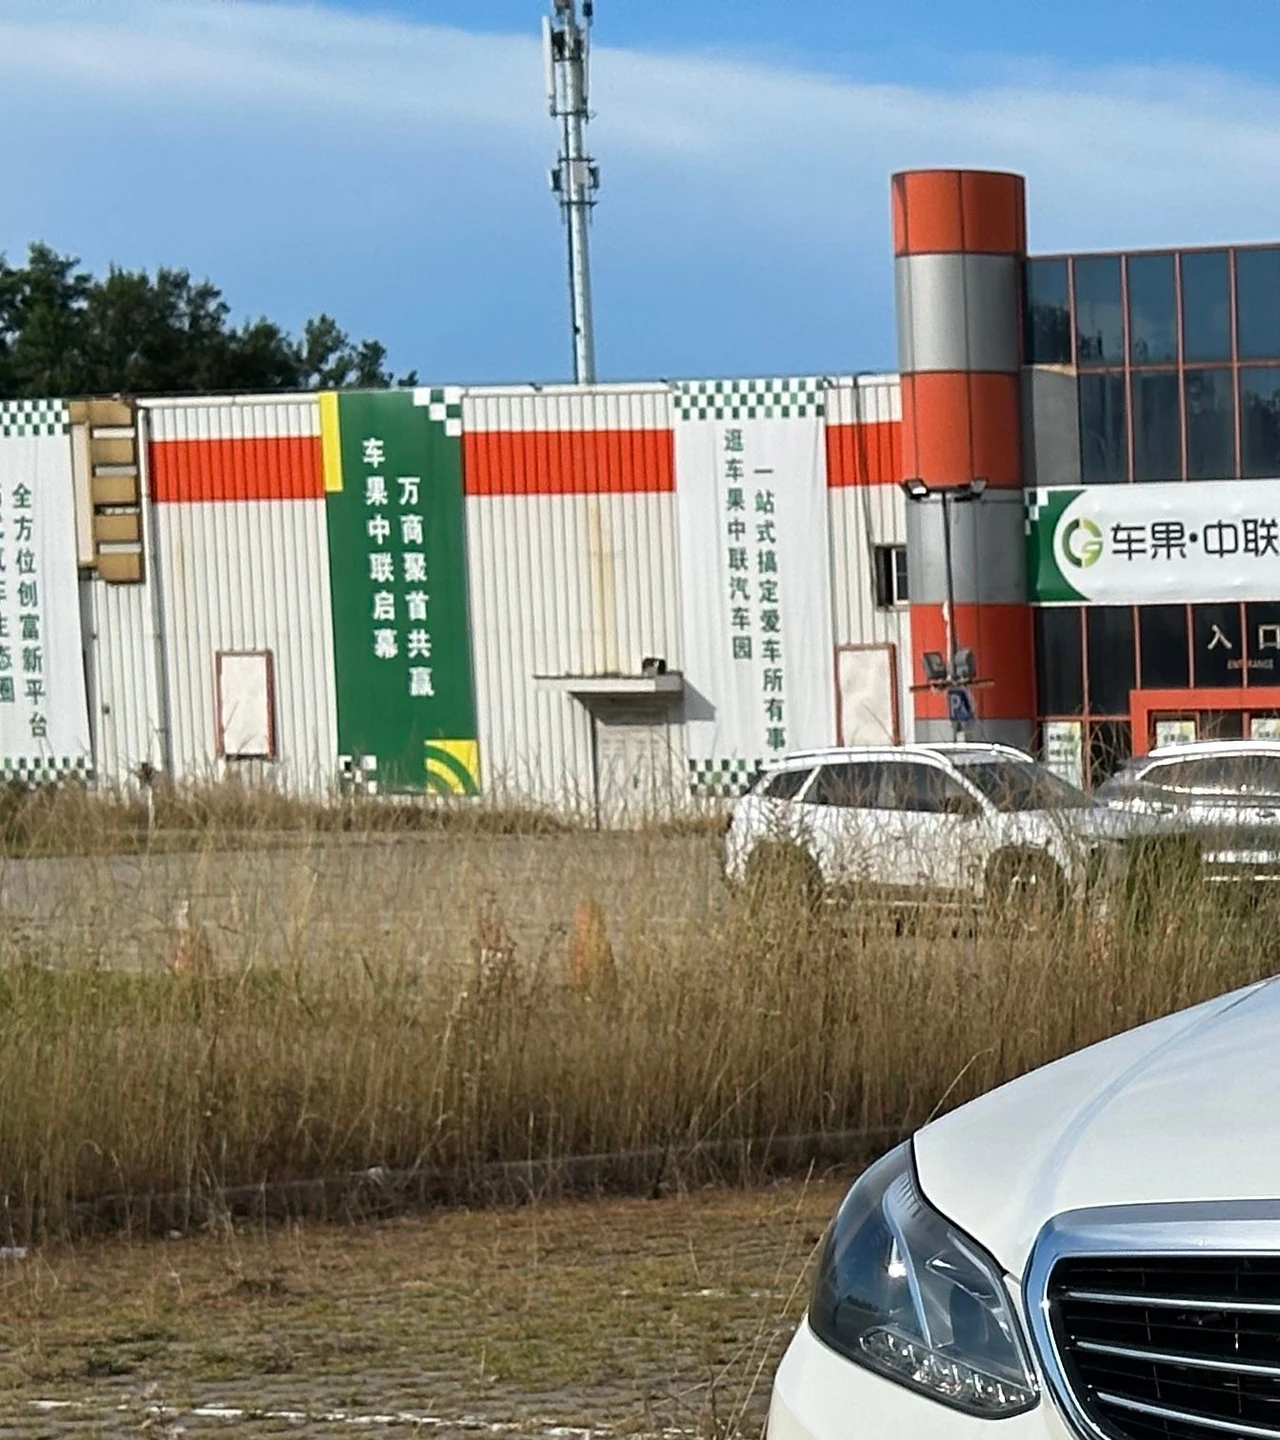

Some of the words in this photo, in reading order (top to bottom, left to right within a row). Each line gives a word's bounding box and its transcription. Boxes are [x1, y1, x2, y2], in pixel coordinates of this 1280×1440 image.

[12, 482, 48, 738] 全方位创富新平台
[362, 437, 399, 660] 车果中联启幕
[397, 476, 435, 697] 万商聚首共赢
[724, 428, 753, 660] 逛车果中联汽车园
[753, 466, 786, 751] 一站式搞定爱车所有事
